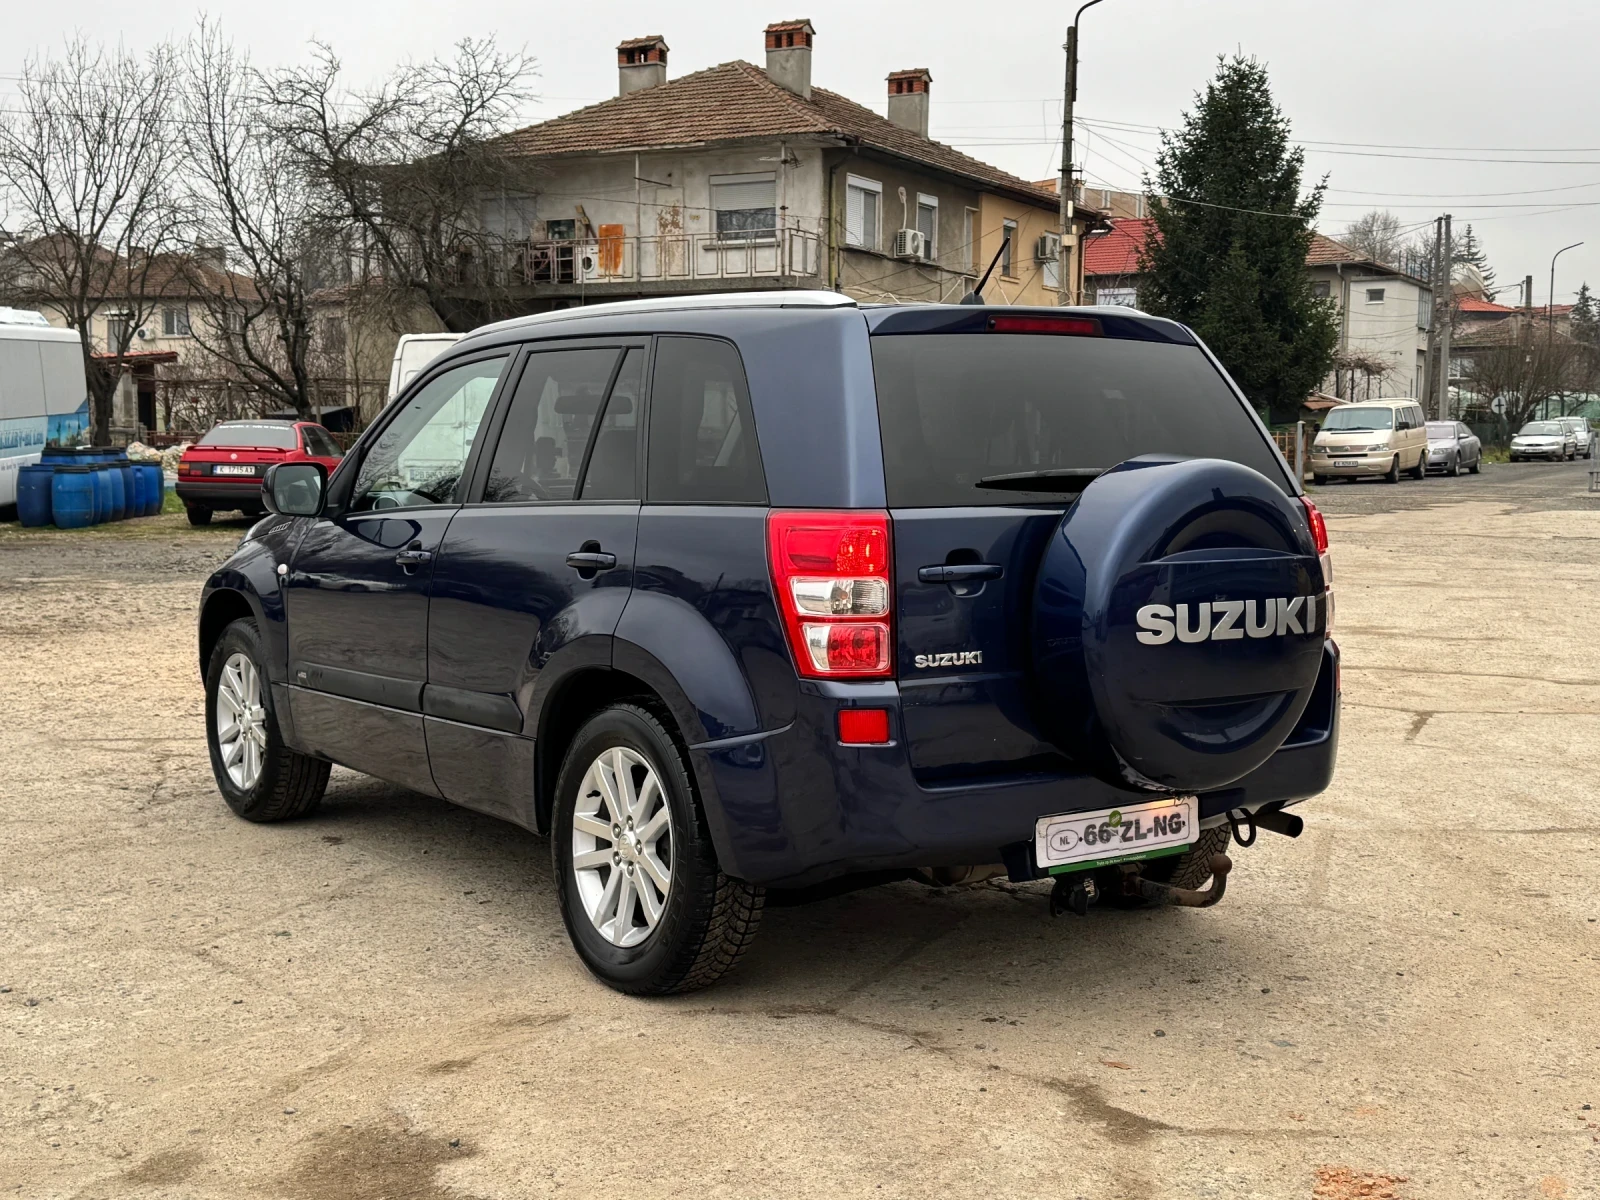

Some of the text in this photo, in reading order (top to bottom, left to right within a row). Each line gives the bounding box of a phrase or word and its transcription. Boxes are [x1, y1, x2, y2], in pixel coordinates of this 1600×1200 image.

[1135, 595, 1316, 645] SUZUKI
[914, 650, 983, 668] SUZUKI
[1059, 835, 1071, 847] NL
